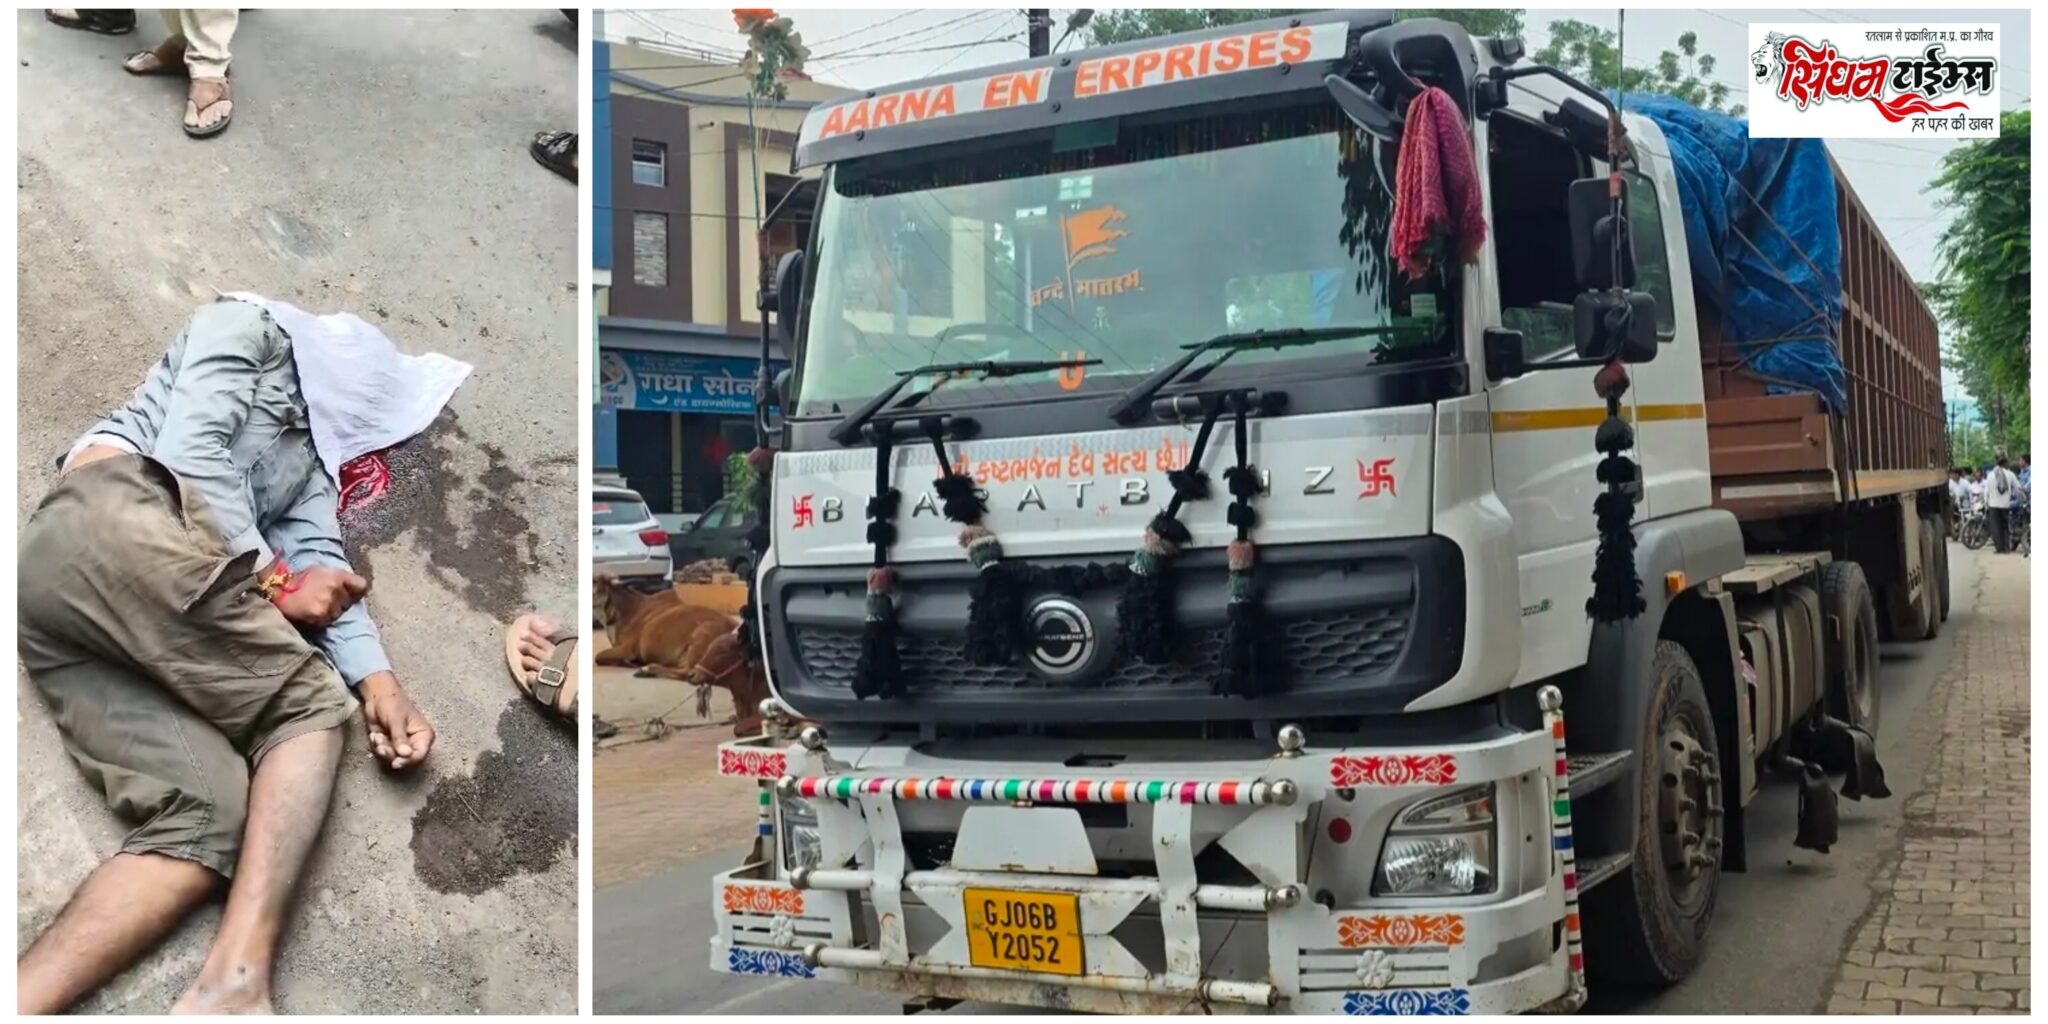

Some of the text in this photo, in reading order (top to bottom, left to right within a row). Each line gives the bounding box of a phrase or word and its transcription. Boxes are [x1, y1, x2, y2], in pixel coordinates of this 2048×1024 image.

[820, 84, 957, 139] AARNA
[984, 899, 1058, 931] GJ06B
[986, 926, 1061, 964] Y2052
